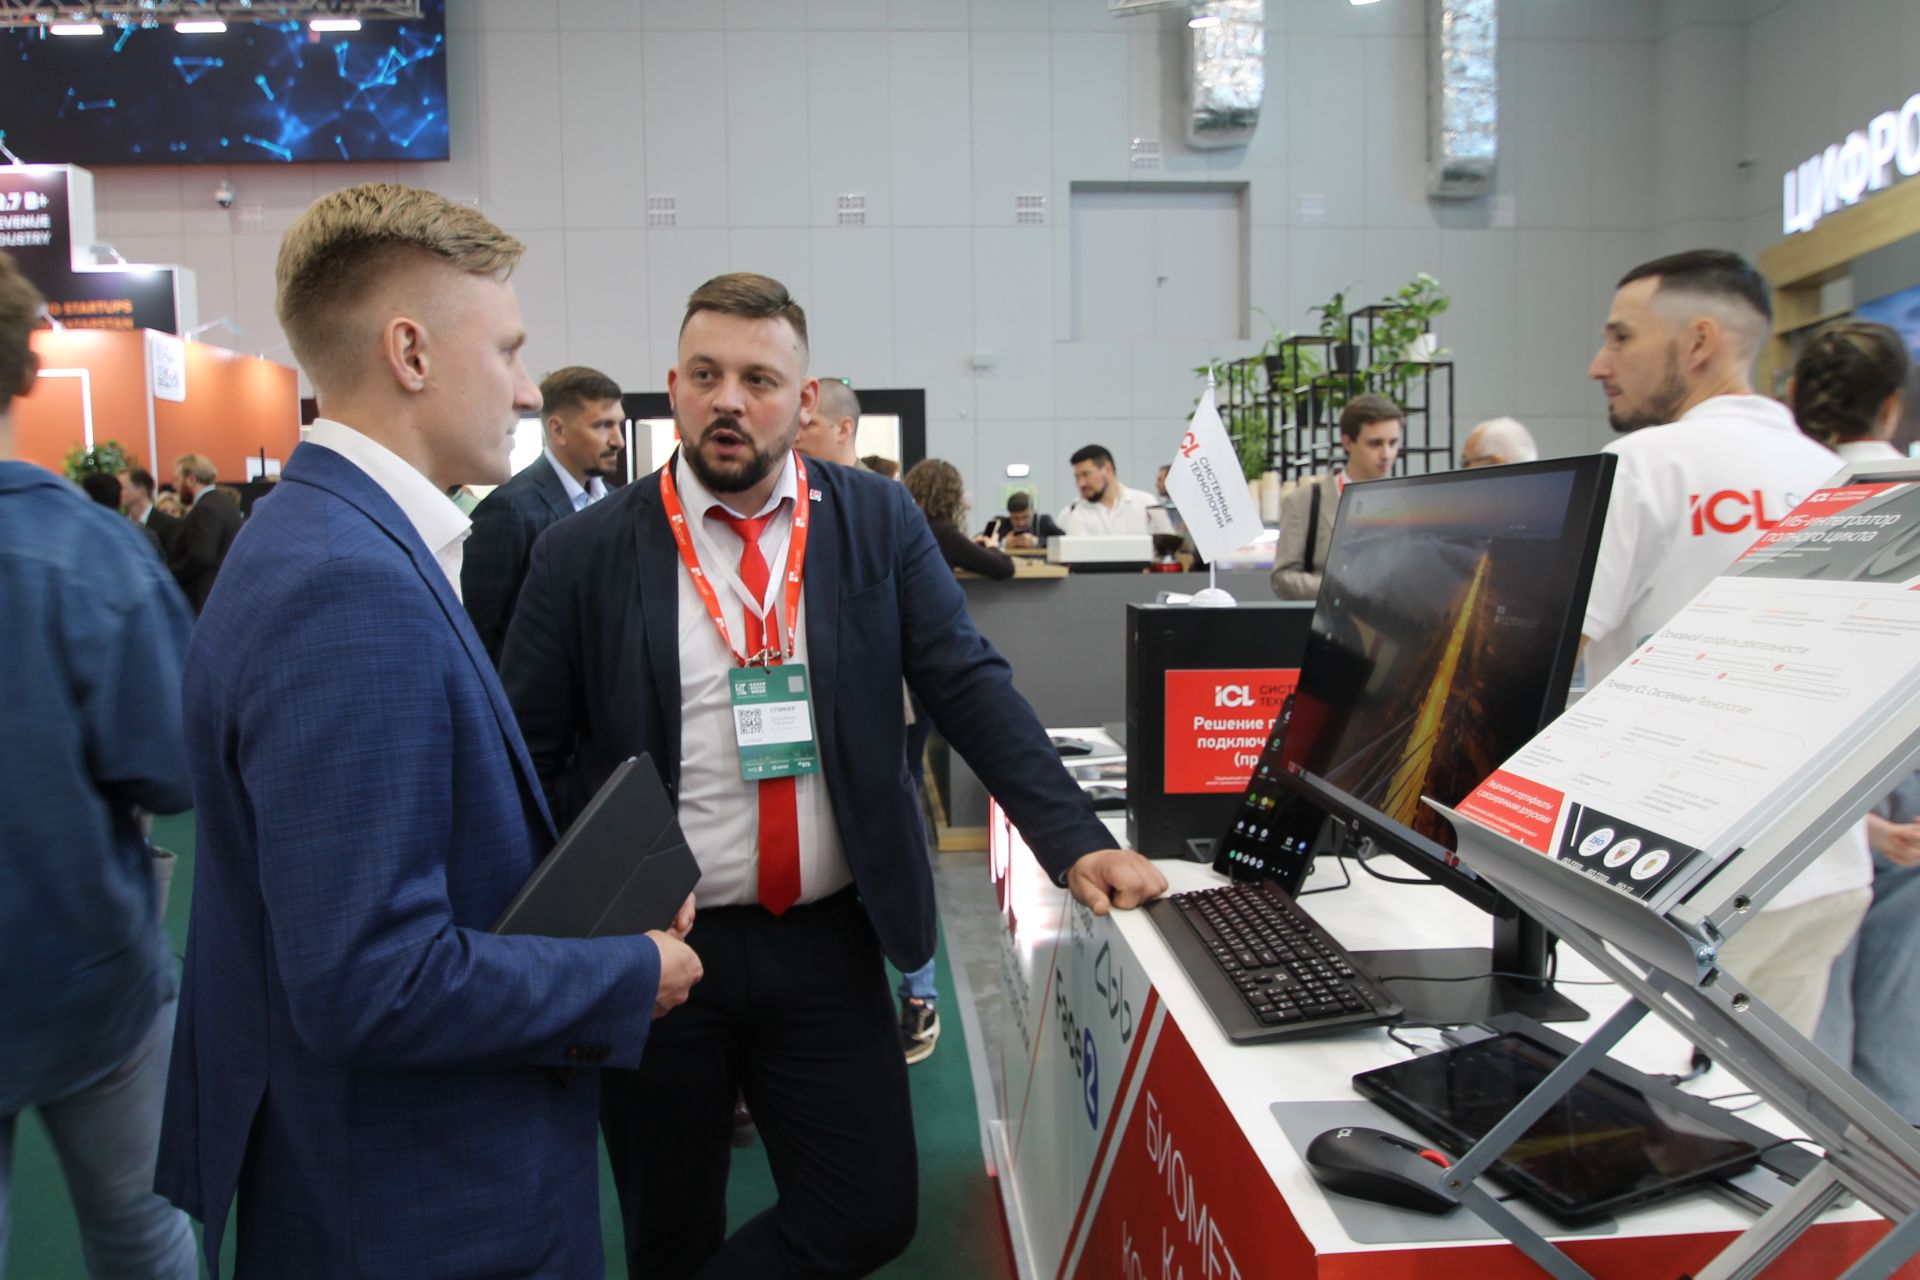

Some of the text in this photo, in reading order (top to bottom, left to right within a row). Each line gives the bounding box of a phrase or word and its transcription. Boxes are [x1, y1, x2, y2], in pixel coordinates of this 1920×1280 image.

[63, 299, 133, 315] STARTUPS
[1189, 461, 1225, 529] ТЕХНОЛОГИИ
[1199, 456, 1234, 525] СИСТЕМНЫЕ
[1690, 490, 1781, 537] ICL
[1215, 685, 1255, 707] ICL
[1193, 716, 1264, 731] Решение
[1197, 737, 1266, 751] подключ
